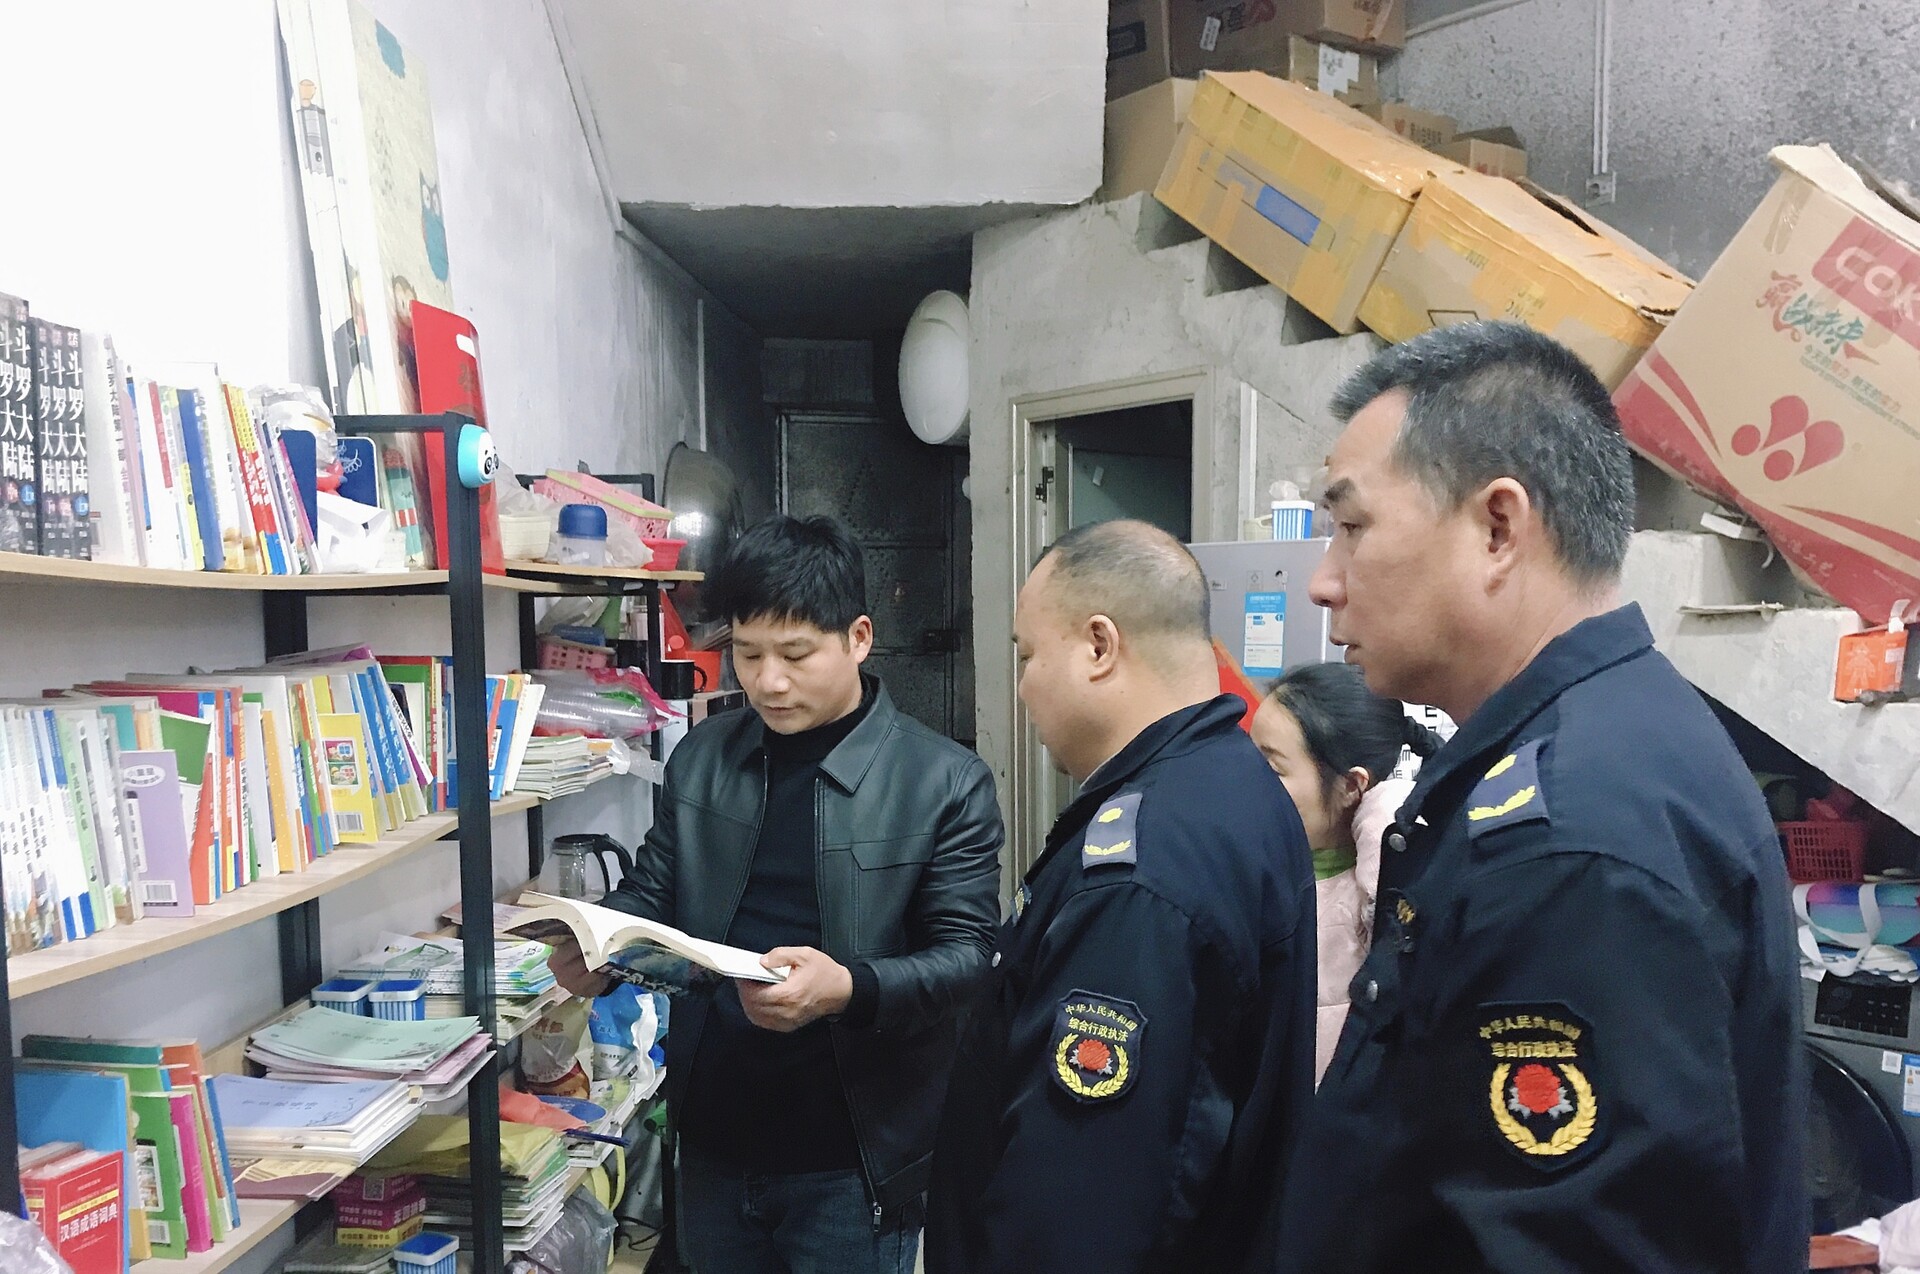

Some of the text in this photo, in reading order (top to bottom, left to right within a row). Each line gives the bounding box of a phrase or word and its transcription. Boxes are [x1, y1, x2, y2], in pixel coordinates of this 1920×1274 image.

[14, 325, 35, 482] 斗罗大陆
[51, 349, 71, 495] 斗罗大陆
[66, 350, 89, 494] 斗罗大陆
[1065, 1003, 1138, 1031] 中华人民共和国
[1068, 1016, 1129, 1042] 综合行政执法
[60, 1202, 118, 1243] 汉语成语词典
